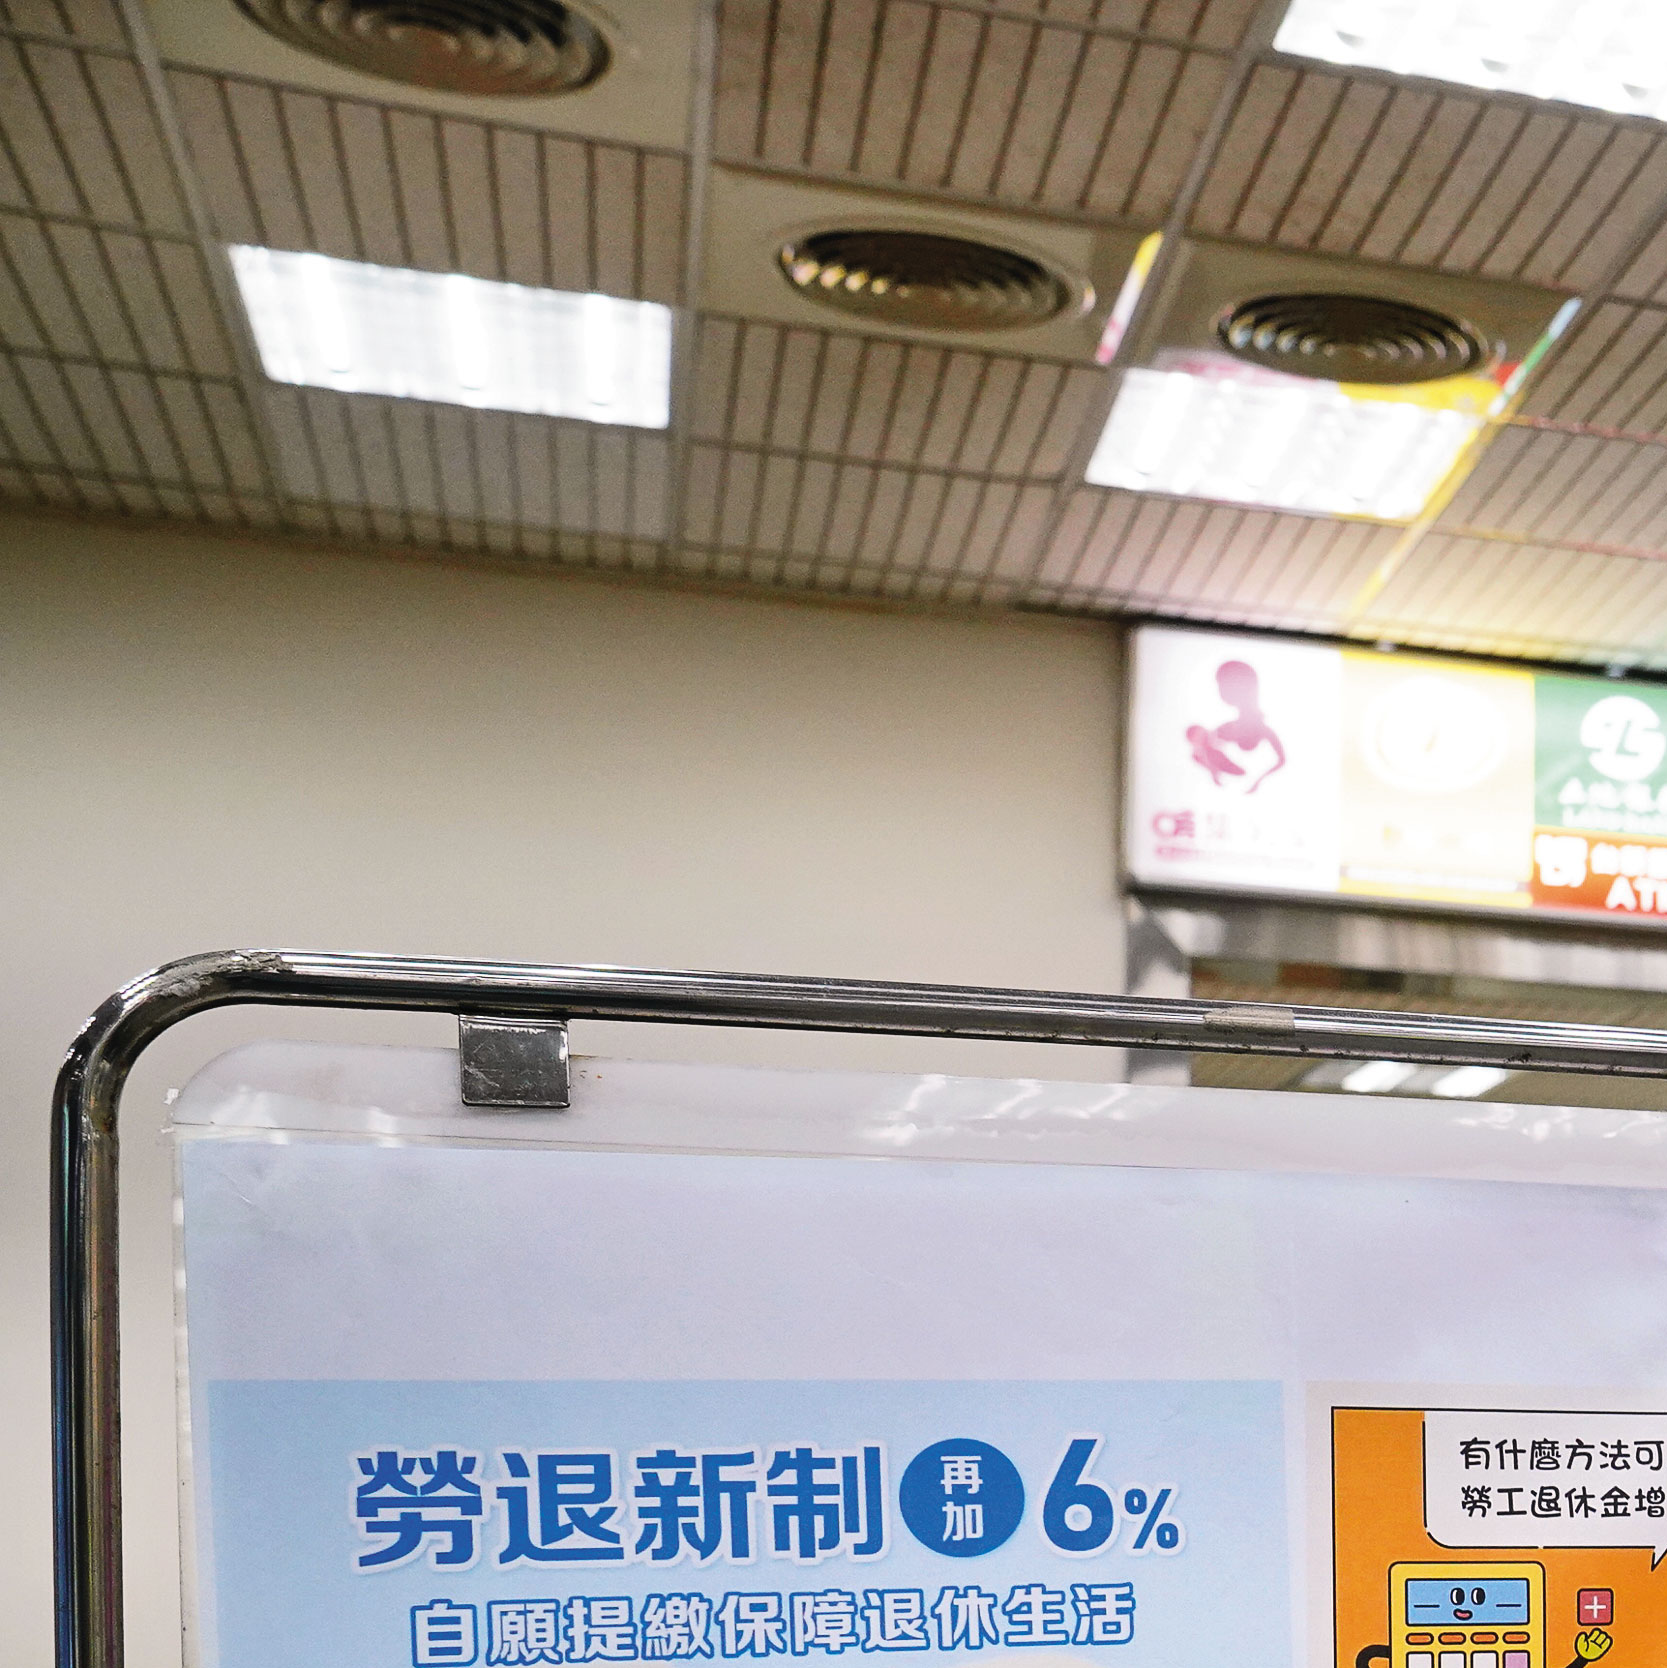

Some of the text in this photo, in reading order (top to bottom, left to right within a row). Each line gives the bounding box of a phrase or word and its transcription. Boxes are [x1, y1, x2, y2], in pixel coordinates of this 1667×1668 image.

[355, 1446, 883, 1568] 勞退新制
[1042, 1438, 1180, 1552] 6%
[411, 1583, 1137, 1668] 自願提繳保障退休生活
